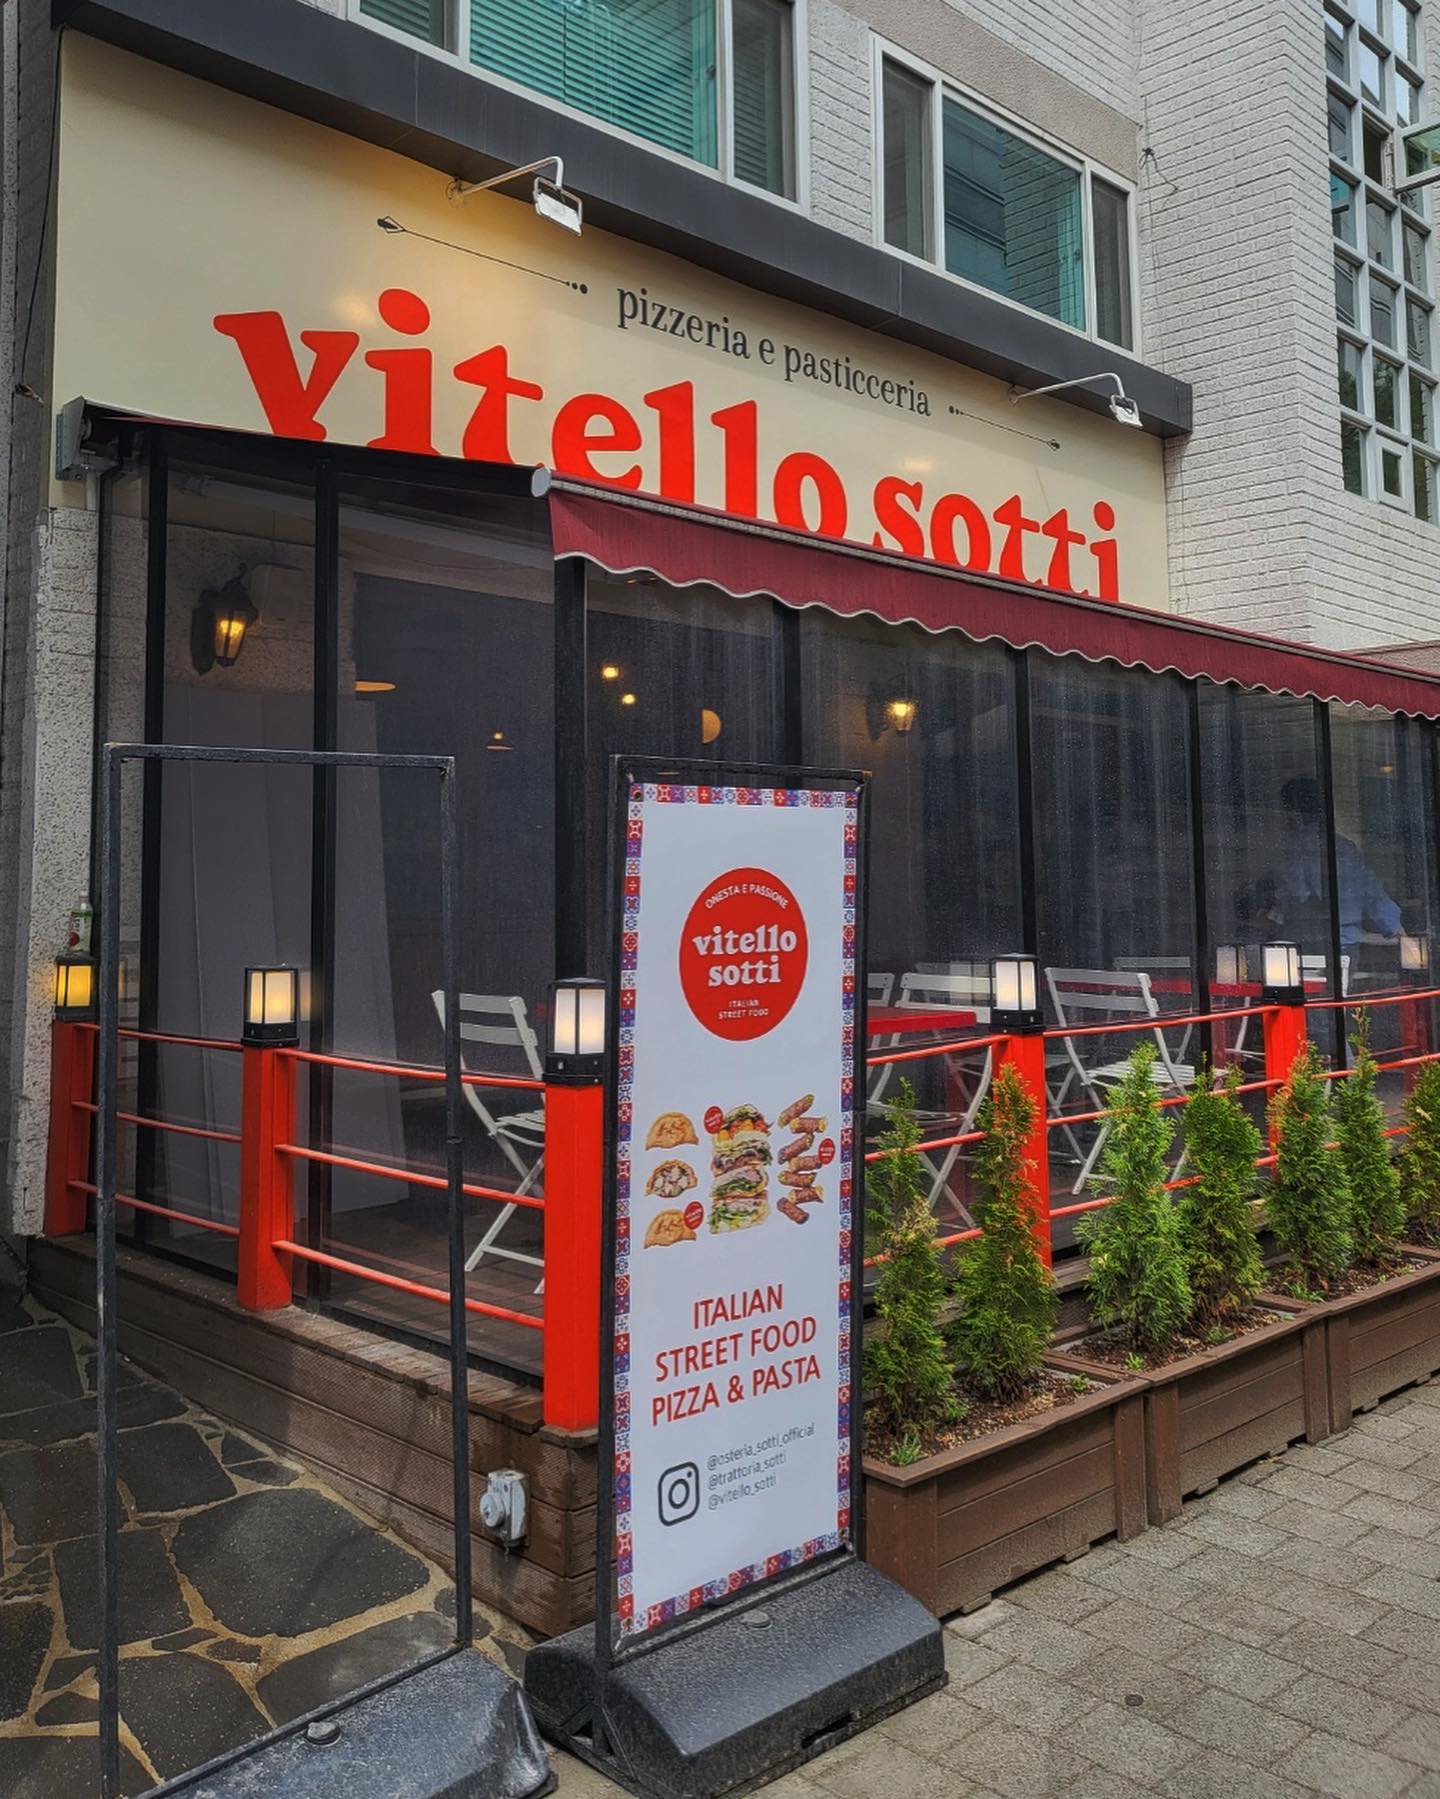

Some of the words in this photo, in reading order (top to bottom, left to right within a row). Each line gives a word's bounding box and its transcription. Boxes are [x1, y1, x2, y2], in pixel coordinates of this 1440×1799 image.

[617, 287, 751, 360] pizzeria
[758, 336, 775, 366] e
[784, 343, 932, 417] pasticceria
[213, 288, 848, 542] vitello
[873, 475, 1119, 602] sotti
[705, 885, 740, 909] ONESTA
[742, 884, 748, 894] E
[749, 884, 789, 909] PASSIONE
[692, 924, 798, 956] vitello
[708, 955, 782, 987] sotti
[693, 1284, 784, 1330] ITALIAN
[655, 1332, 744, 1383] STREET
[750, 1316, 817, 1357] FOOD
[651, 1381, 720, 1427] PIZZA
[727, 1375, 745, 1404] &
[752, 1355, 821, 1397] PASTA
[706, 1422, 815, 1471] @osteria_sotti_official
[707, 1451, 787, 1491] @trattoria_sotti
[708, 1475, 777, 1511] @vitello_sotti
